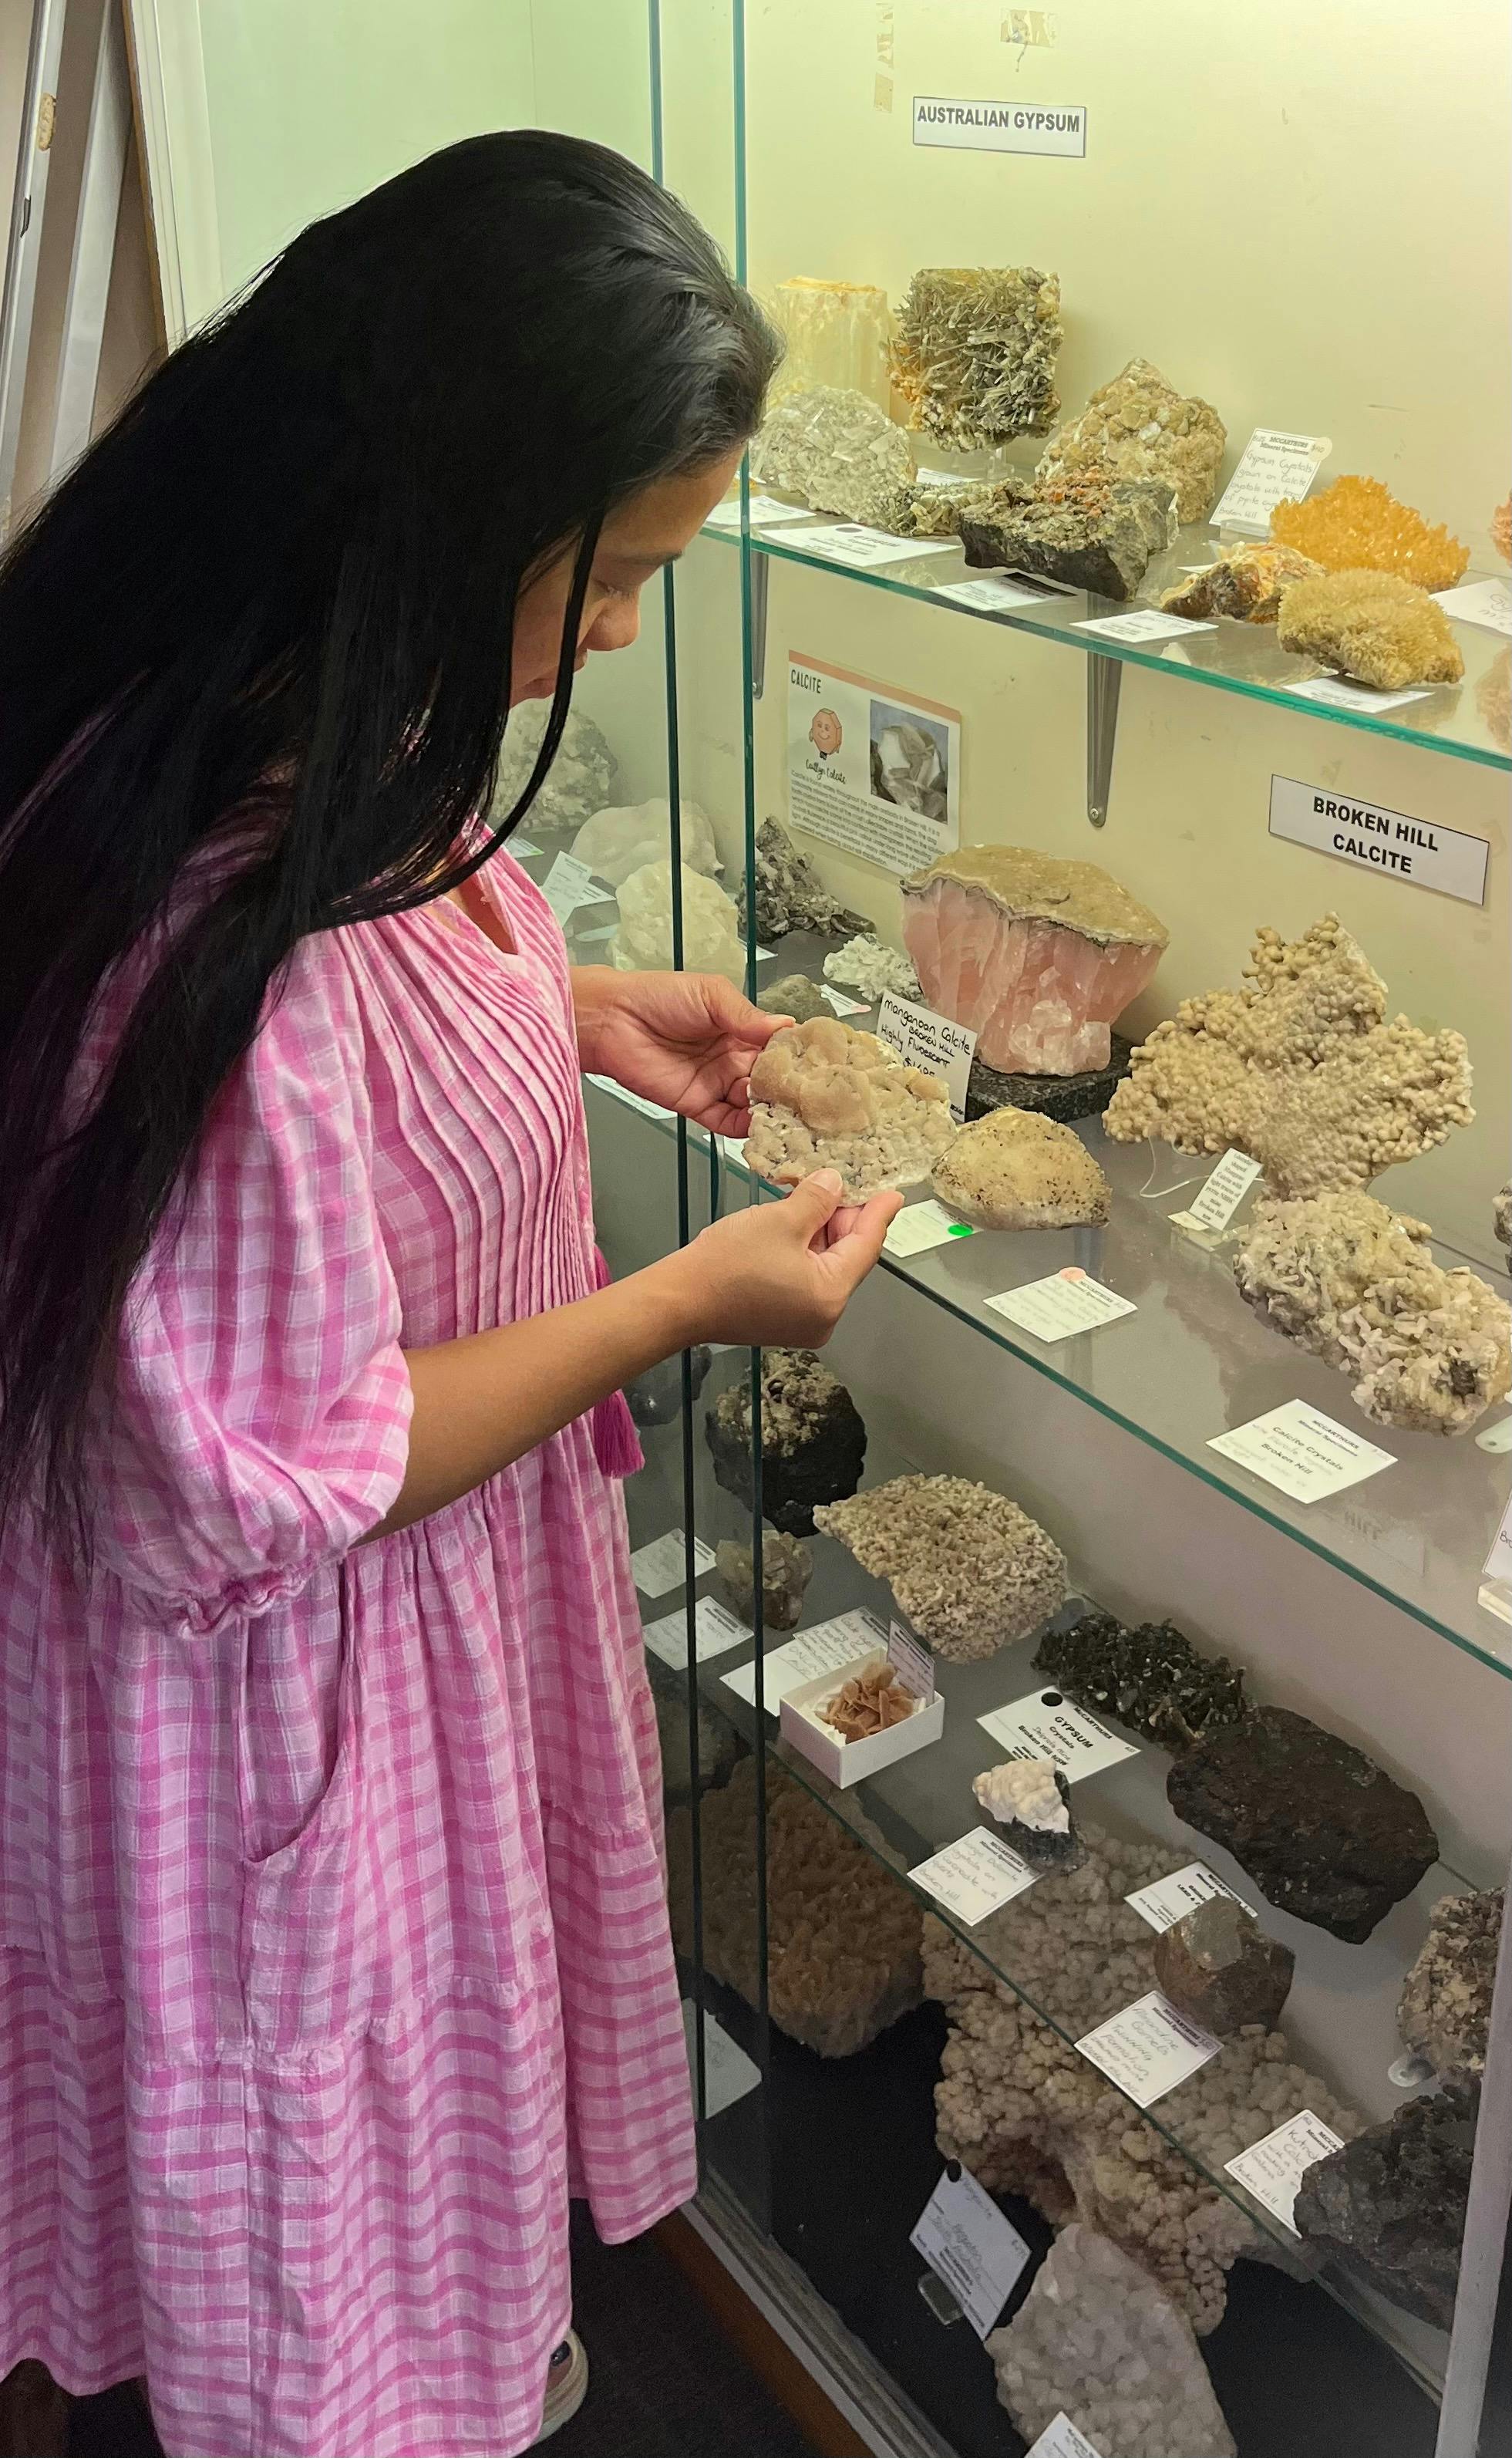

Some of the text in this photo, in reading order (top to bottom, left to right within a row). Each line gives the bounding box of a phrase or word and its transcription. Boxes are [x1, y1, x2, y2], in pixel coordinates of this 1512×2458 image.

[918, 106, 1079, 133] AUSTRALIAN GYPSUM
[1264, 486, 1280, 495] with
[1281, 475, 1306, 487] Calcite
[791, 669, 821, 694] CALCITE
[1313, 796, 1439, 851] BROKEN HILL
[1333, 834, 1412, 873] CALCITE
[881, 1023, 903, 1053] Highly
[909, 1026, 955, 1057] BROKEN HILL
[941, 1027, 971, 1055] Calcite
[1261, 1443, 1313, 1475] Broken Hill
[1273, 1426, 1305, 1447] Calcite
[1305, 1446, 1344, 1471] Crystals
[1018, 1725, 1041, 1745] Broken
[1039, 1744, 1052, 1755] Hill
[1051, 1755, 1069, 1766] NSW
[1049, 1726, 1075, 1749] Crystals
[1054, 1716, 1094, 1748] GYPSUM
[1152, 2007, 1174, 2025] Mineral
[1261, 2189, 1278, 2204] Hill
